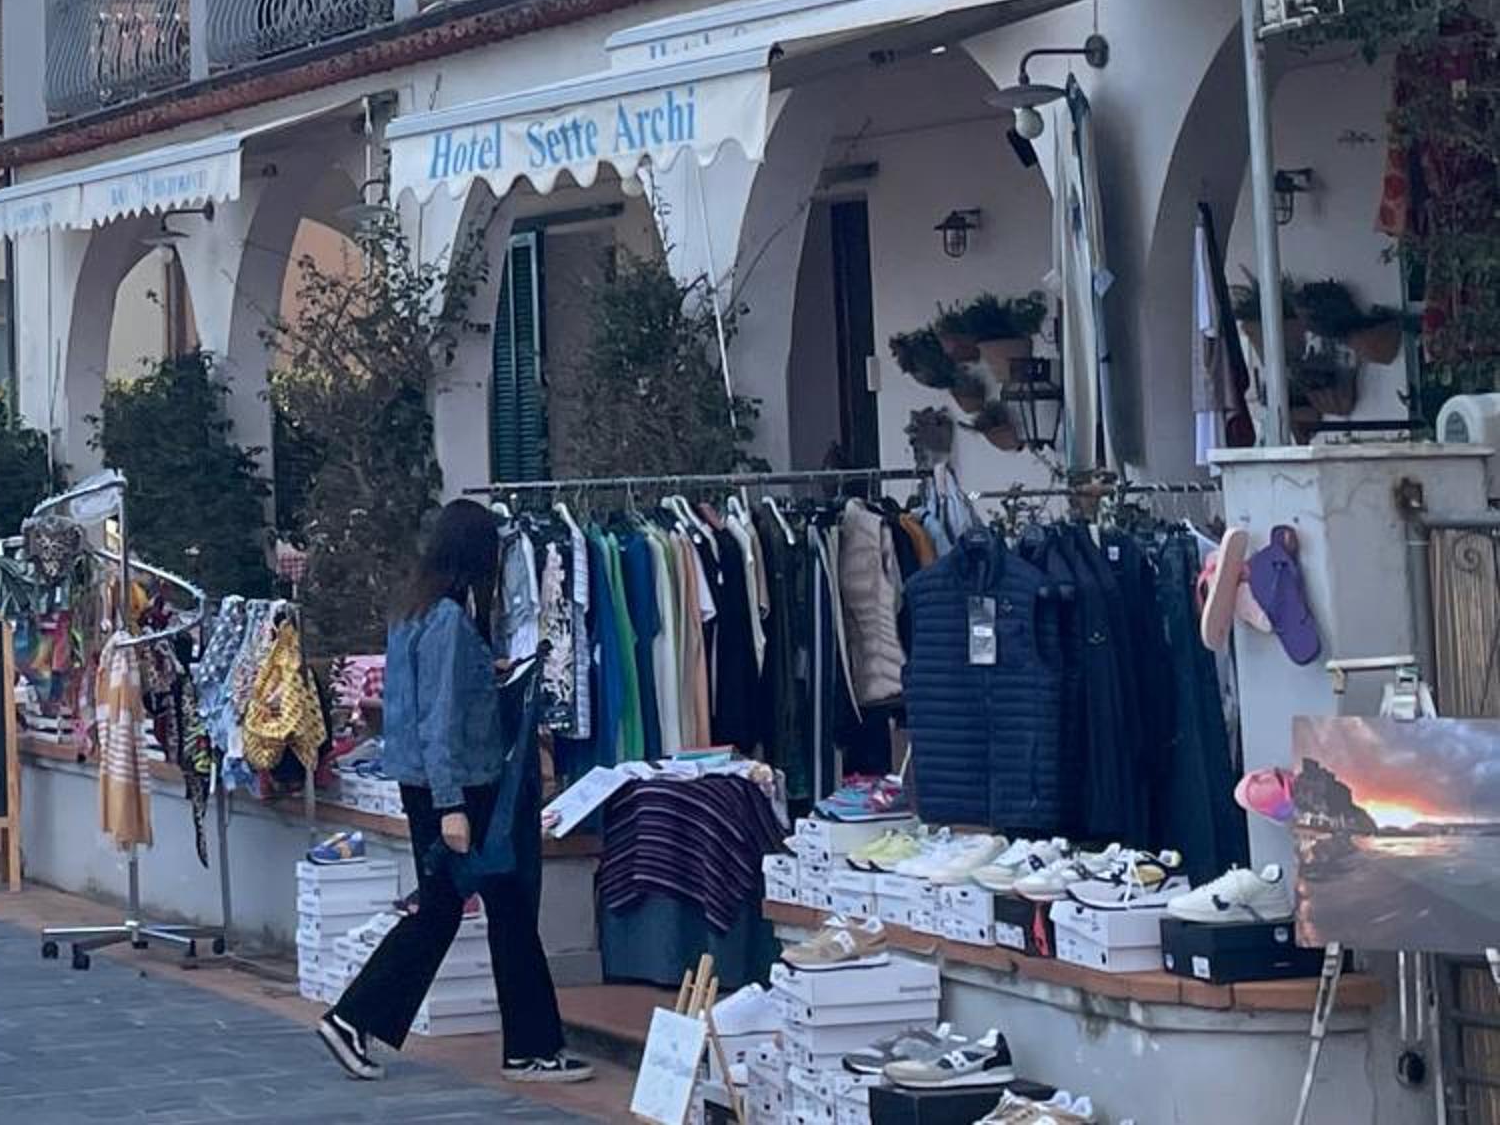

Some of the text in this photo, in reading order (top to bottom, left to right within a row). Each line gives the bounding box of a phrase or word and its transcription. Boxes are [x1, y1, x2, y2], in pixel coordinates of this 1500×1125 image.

[428, 86, 696, 181] Hotel Sette Archi
